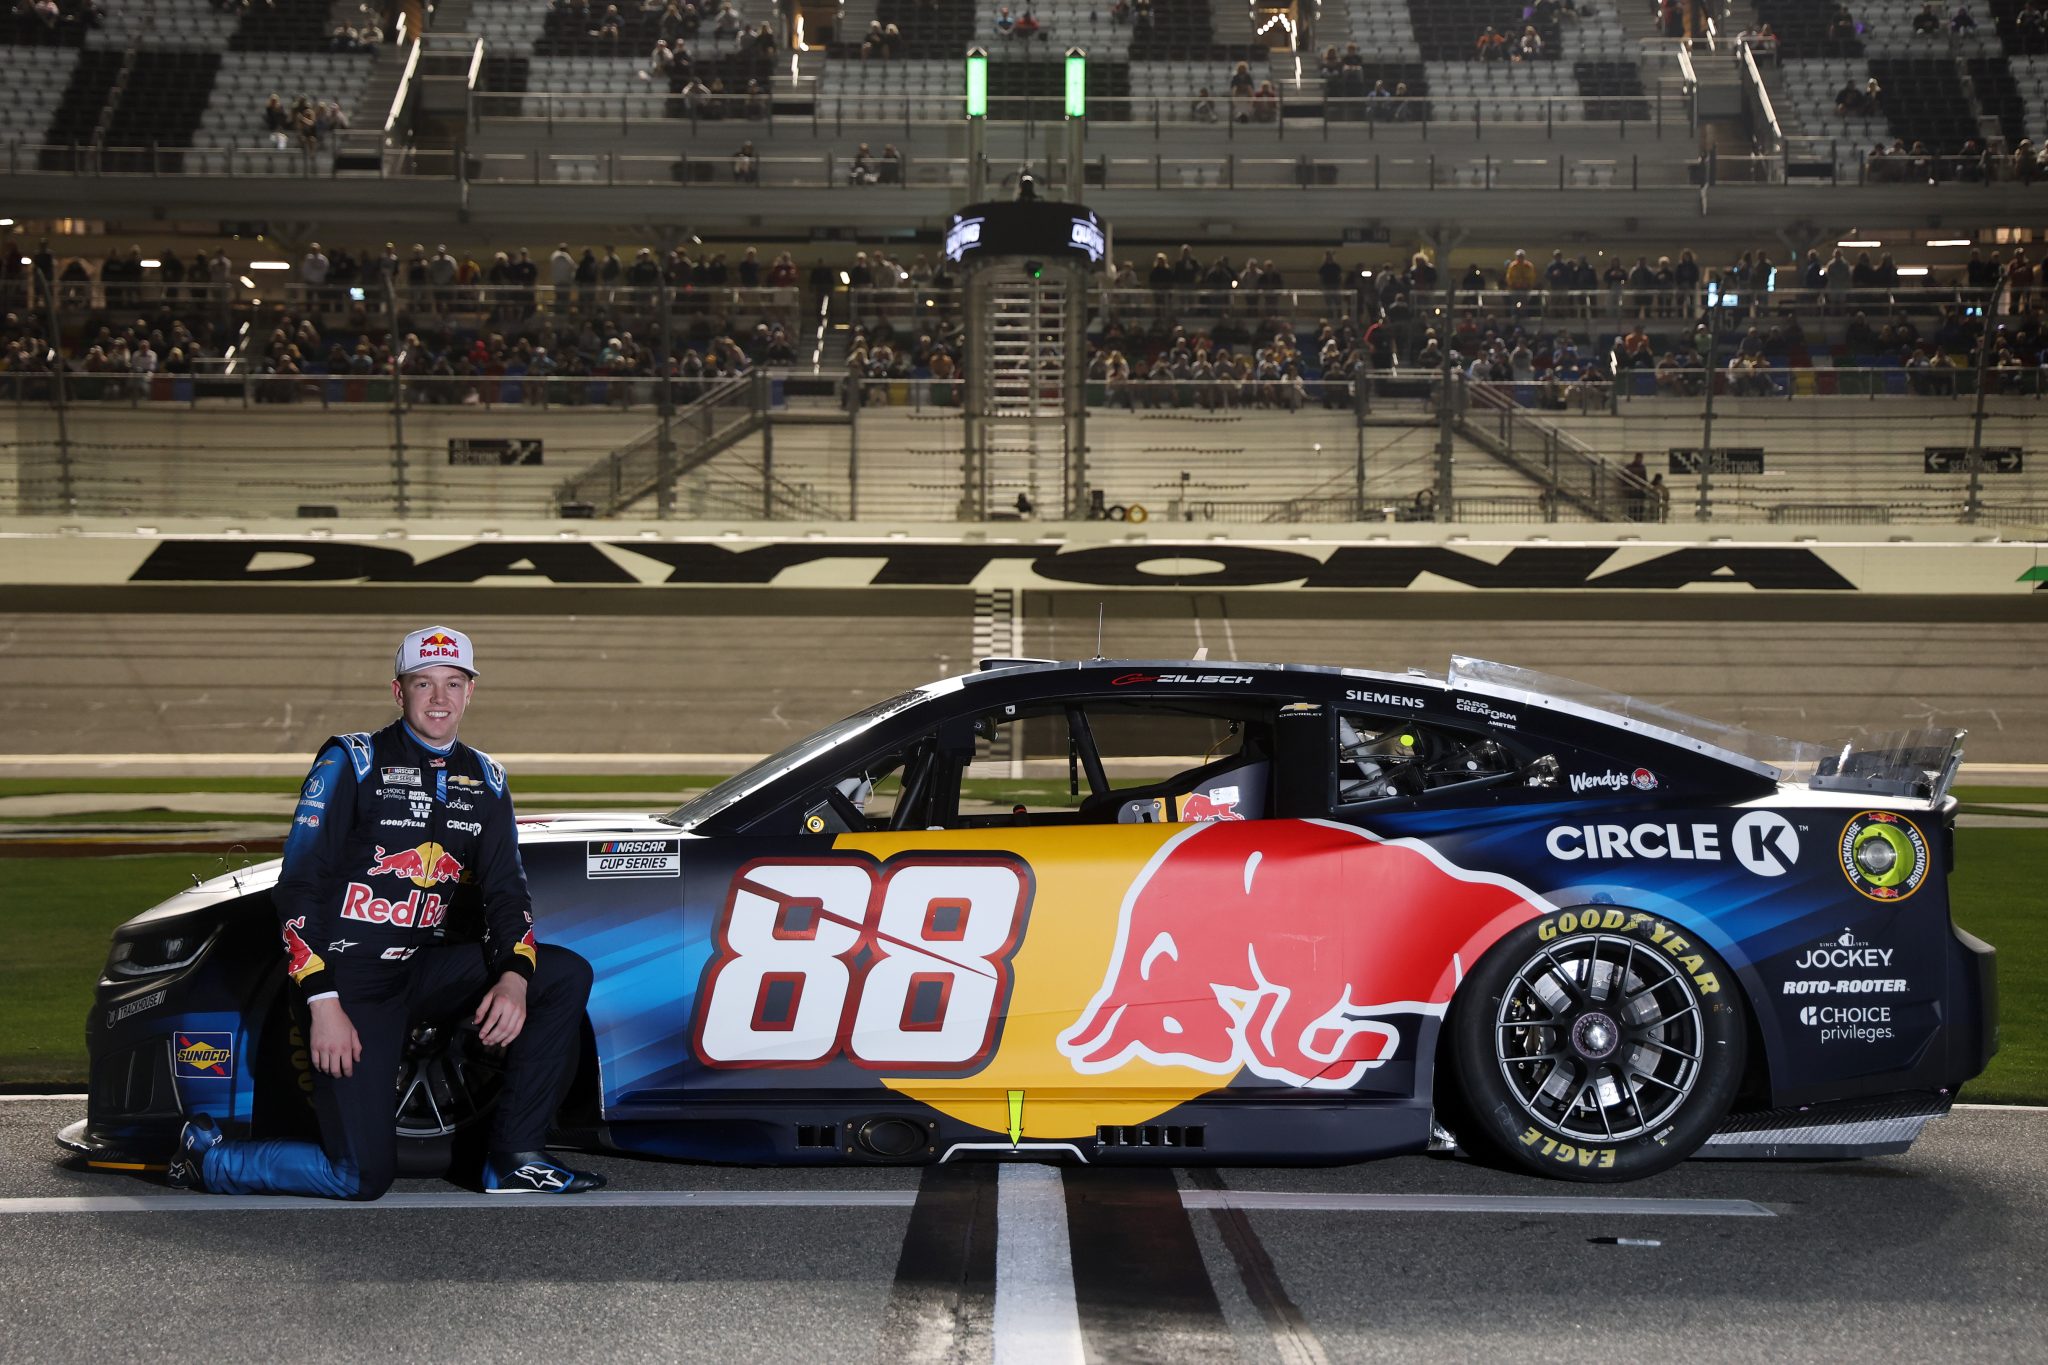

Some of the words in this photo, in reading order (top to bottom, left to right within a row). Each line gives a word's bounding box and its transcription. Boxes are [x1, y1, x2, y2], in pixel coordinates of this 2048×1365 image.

[128, 540, 1859, 590] DAYTONA
[420, 647, 440, 658] Red
[441, 647, 459, 658] Bull
[1156, 674, 1253, 684] ZILISCH
[1346, 690, 1425, 708] SIEMENS
[1456, 698, 1489, 708] FARO
[1456, 704, 1517, 721] CREAFORM
[1488, 720, 1517, 730] AMETEK
[1569, 769, 1628, 793] Wendy's
[445, 801, 474, 811] JOCKEY
[446, 819, 473, 832] CIRCLE
[617, 841, 667, 853] NASCAR
[1545, 822, 1721, 861] CIRCLE
[1743, 819, 1798, 875] K
[1842, 821, 1861, 884] TRACKHOUSE
[600, 858, 625, 870] CUP
[625, 857, 668, 869] SERIES
[1906, 826, 1926, 889] TRACKHOUSE
[340, 881, 421, 928] Red
[1537, 908, 1720, 996] GOODYEAR
[1796, 948, 1893, 968] JOCKEY
[694, 856, 1031, 1072] 88
[1783, 979, 1907, 994] ROTO-ROOTER
[1820, 1006, 1891, 1023] CHOICE
[178, 1049, 229, 1063] SUNOCO
[1517, 1126, 1616, 1168] EAGLE
